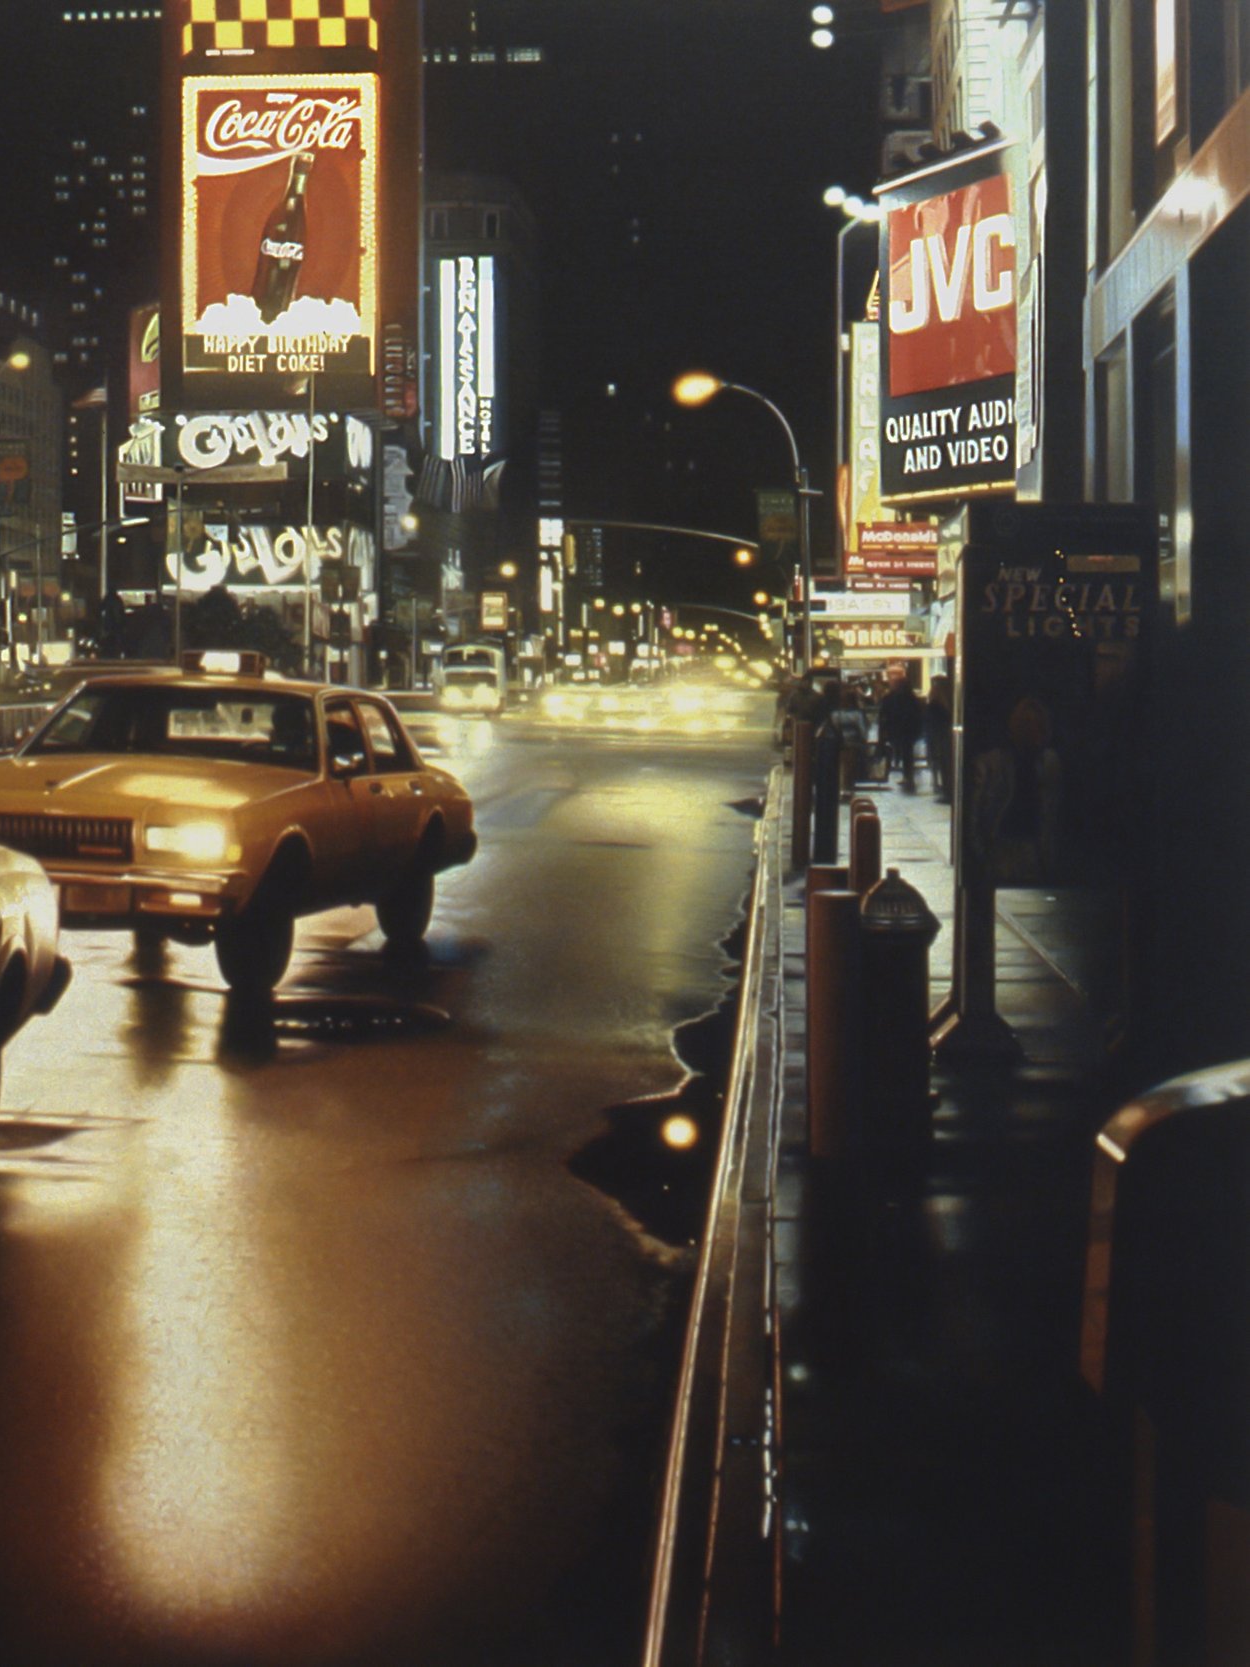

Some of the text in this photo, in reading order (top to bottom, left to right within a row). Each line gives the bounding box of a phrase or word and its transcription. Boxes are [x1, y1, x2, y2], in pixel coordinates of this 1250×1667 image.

[205, 97, 357, 151] Coca-Cola
[889, 213, 1015, 333] JVC
[228, 354, 325, 372] DIET COKE!
[886, 398, 1016, 443] QUALITY AUDI
[904, 435, 1009, 474] AND VIDEO
[862, 530, 938, 543] McDonald's
[999, 567, 1042, 581] NEW
[982, 583, 1141, 612] SPECIAL
[1006, 615, 1141, 638] LIGHTS
